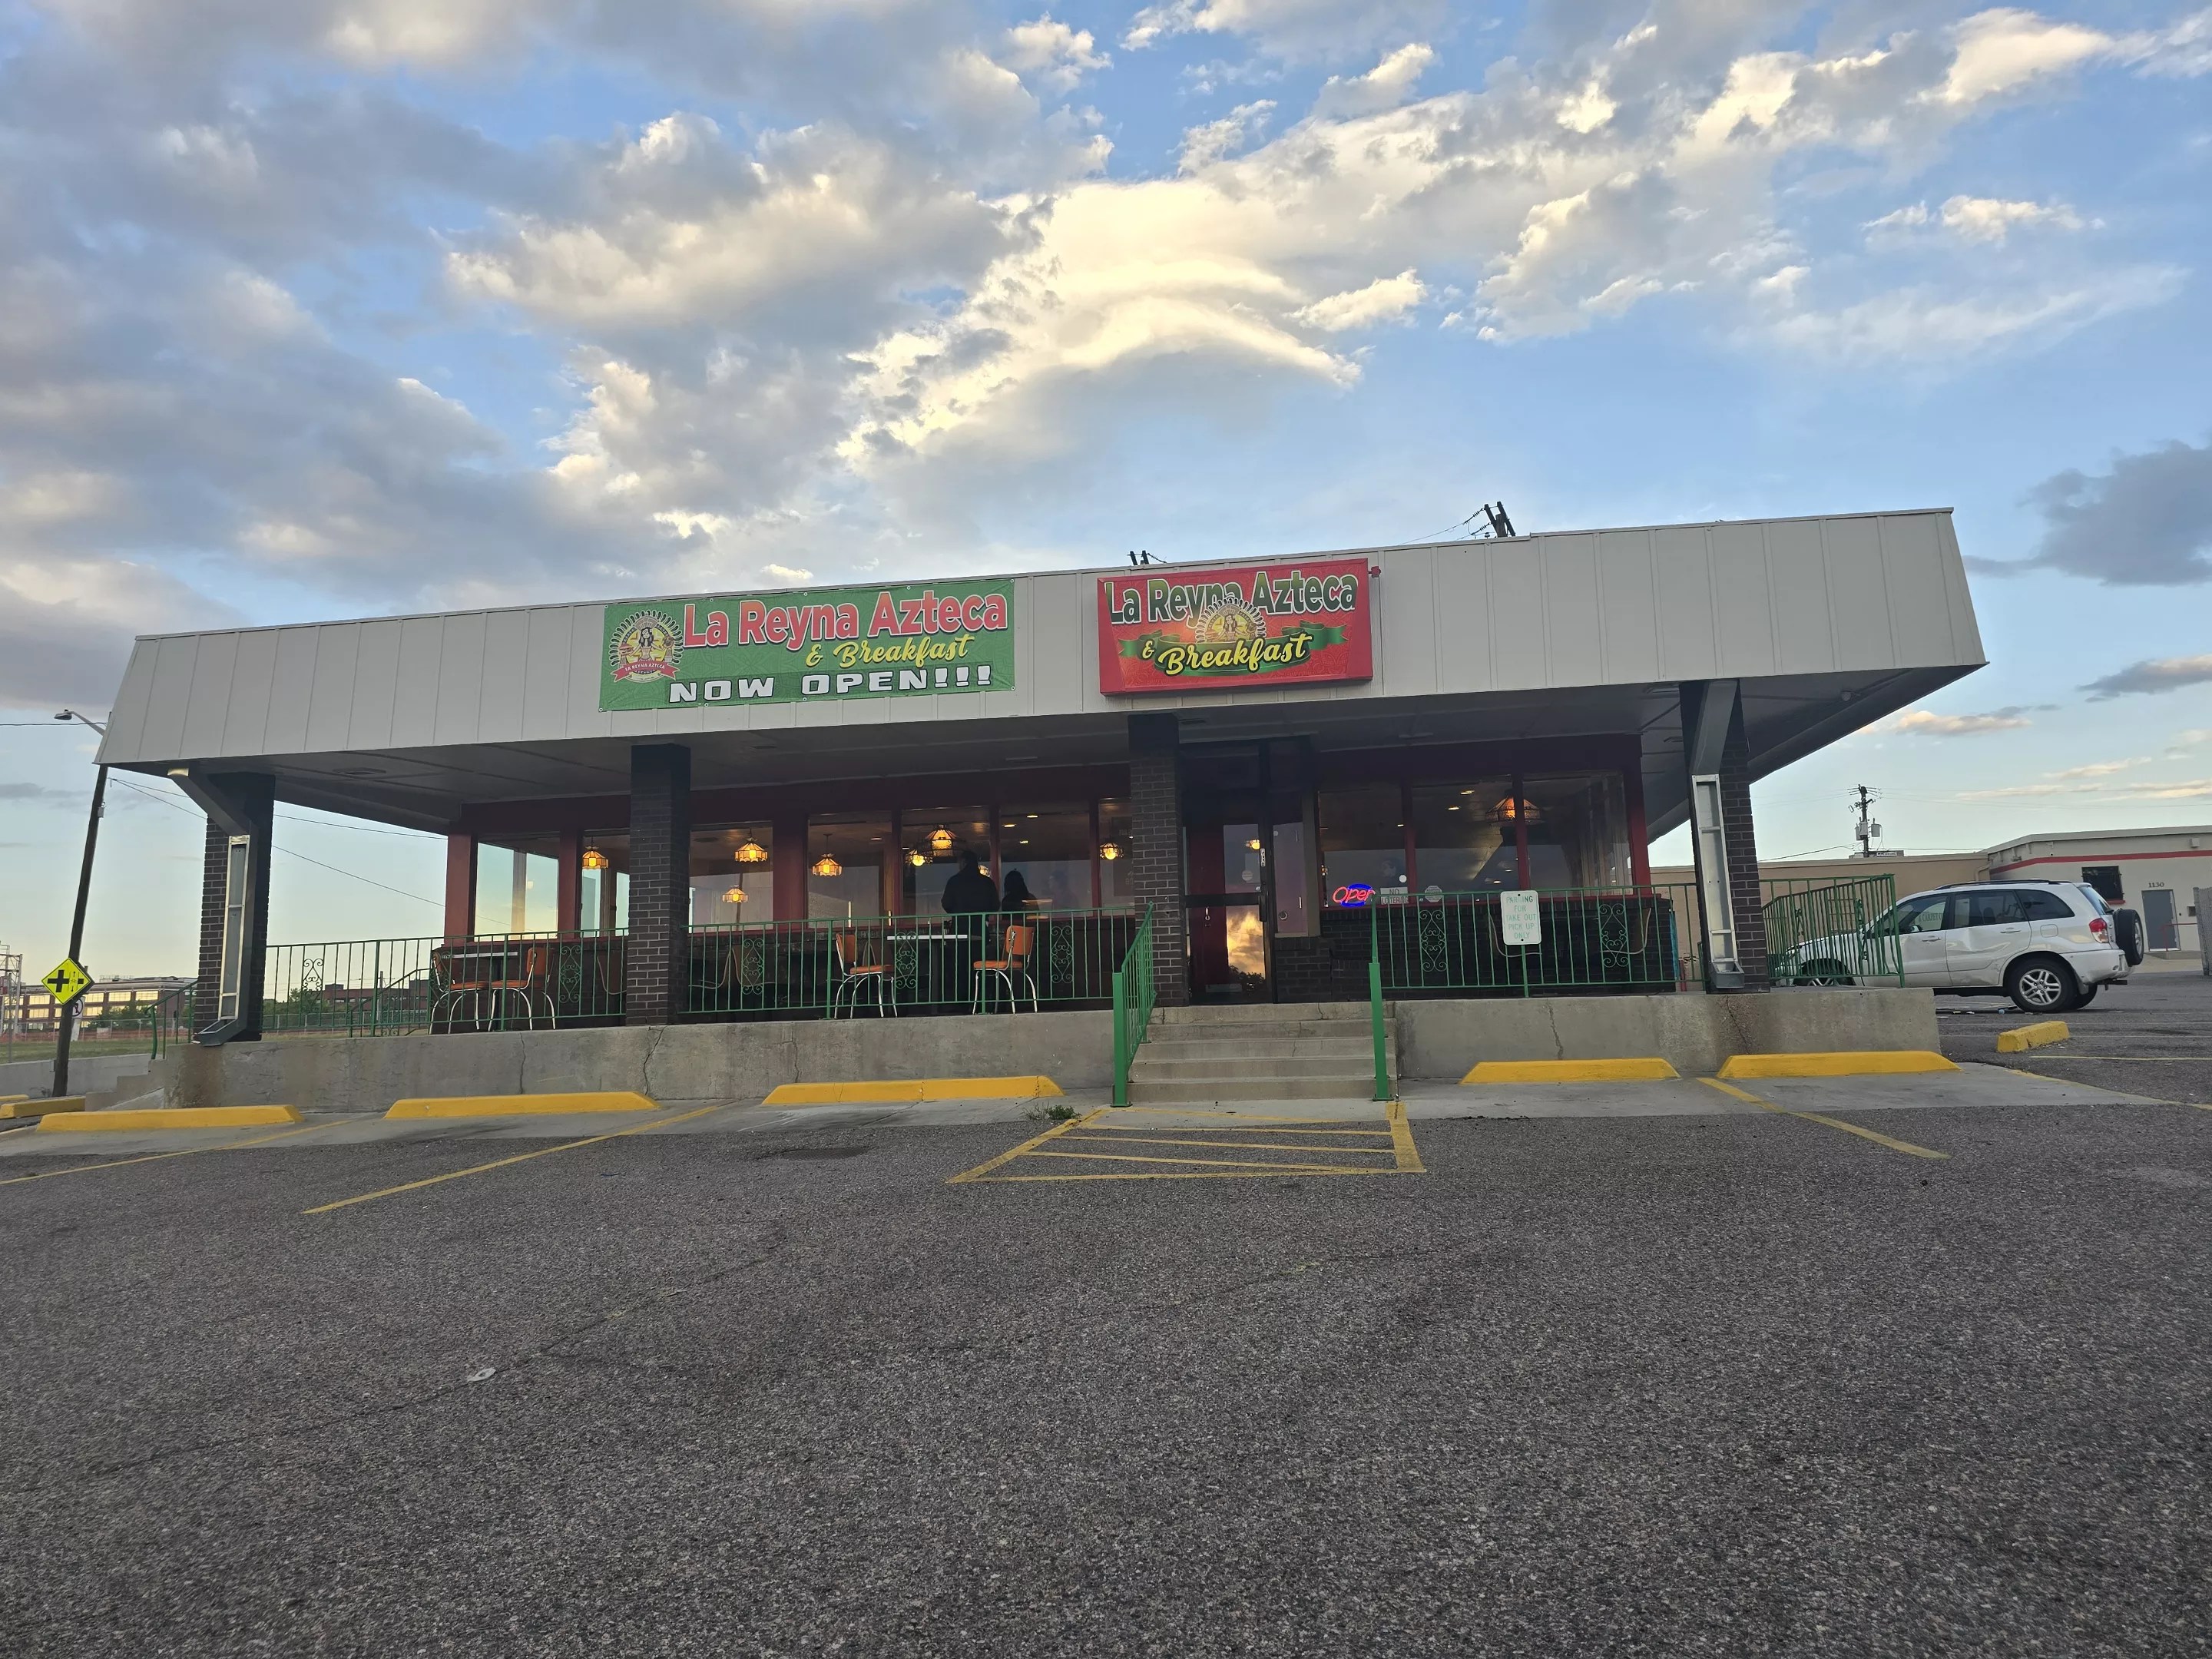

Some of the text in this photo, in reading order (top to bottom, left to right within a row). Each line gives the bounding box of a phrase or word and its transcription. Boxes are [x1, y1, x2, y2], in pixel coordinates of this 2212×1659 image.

[683, 590, 1008, 651] La Reyna Azteca
[1104, 571, 1358, 628] La Reyna Azteca
[806, 634, 975, 668] & Breakfast
[1142, 633, 1313, 675] & Breakfast
[668, 665, 992, 704] NOW OPEN!!!
